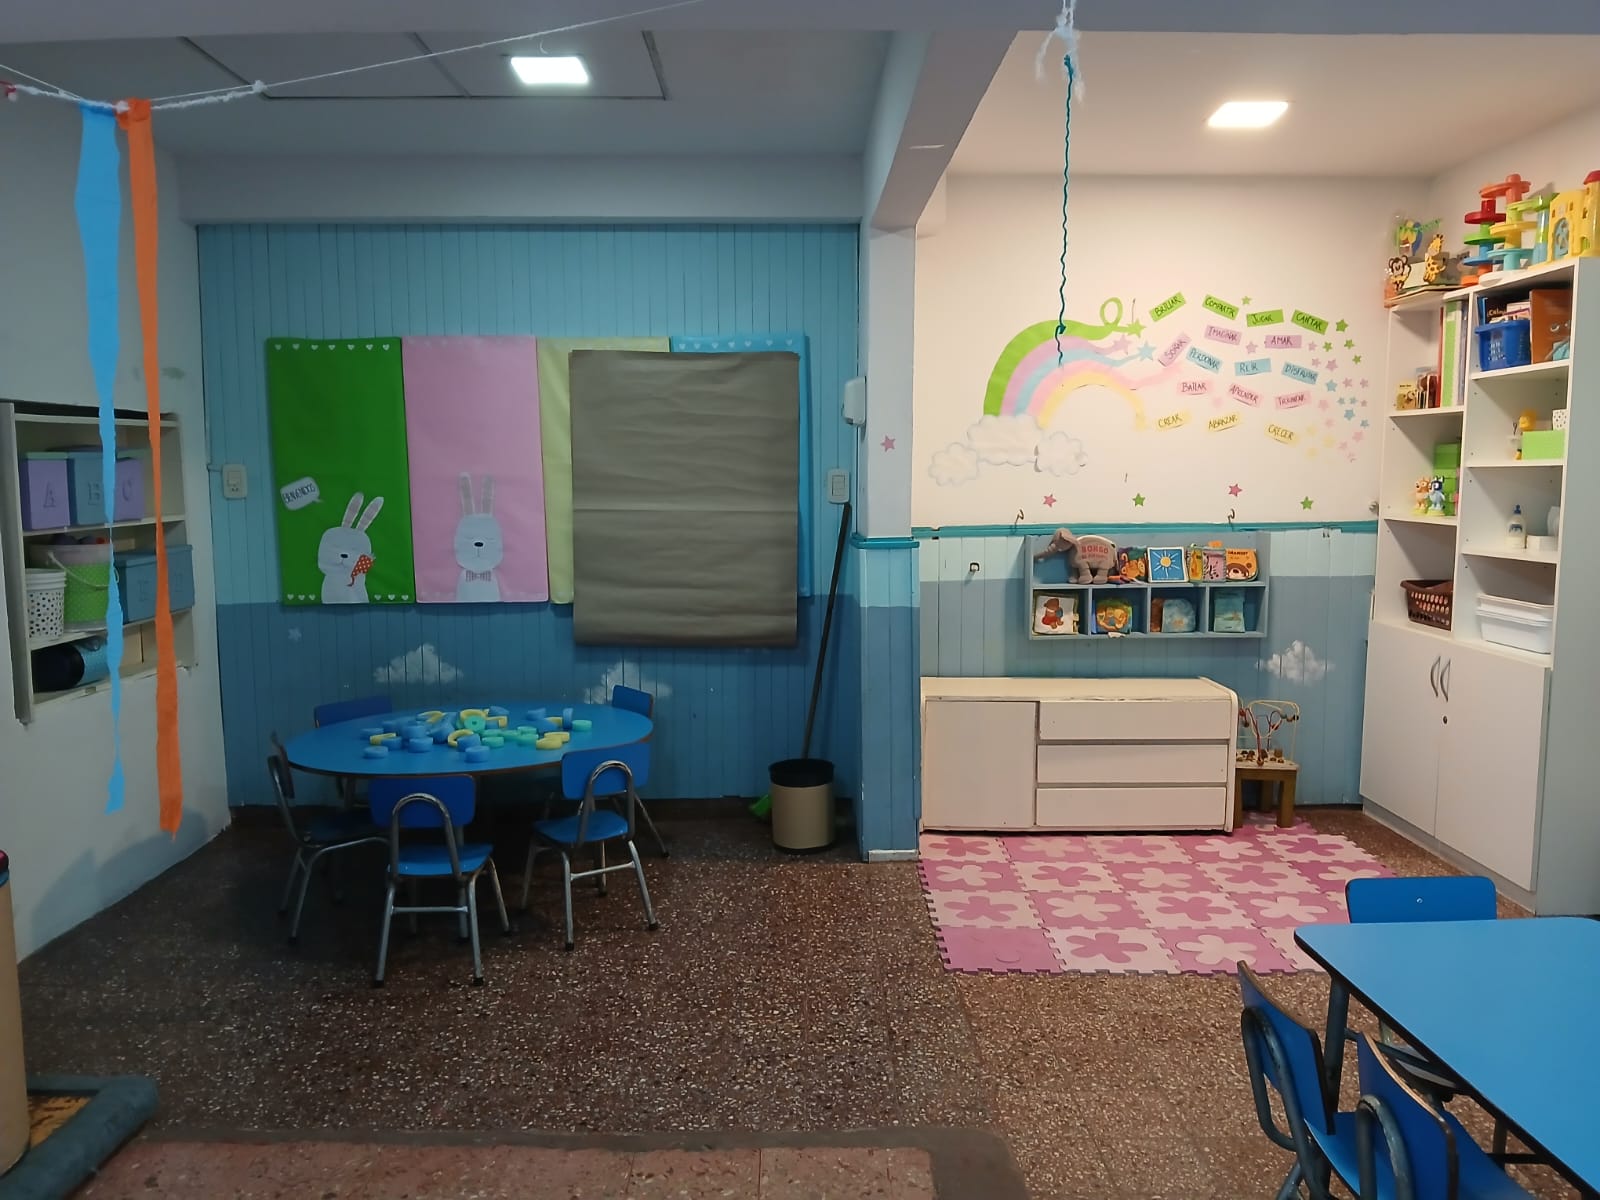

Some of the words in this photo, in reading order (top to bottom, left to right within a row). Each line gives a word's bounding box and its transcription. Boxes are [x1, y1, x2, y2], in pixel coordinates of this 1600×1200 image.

[1296, 312, 1322, 330] CANTAR
[1270, 336, 1293, 346] AMAR
[1181, 381, 1207, 393] BAILAR
[1158, 412, 1183, 428] CREAR
